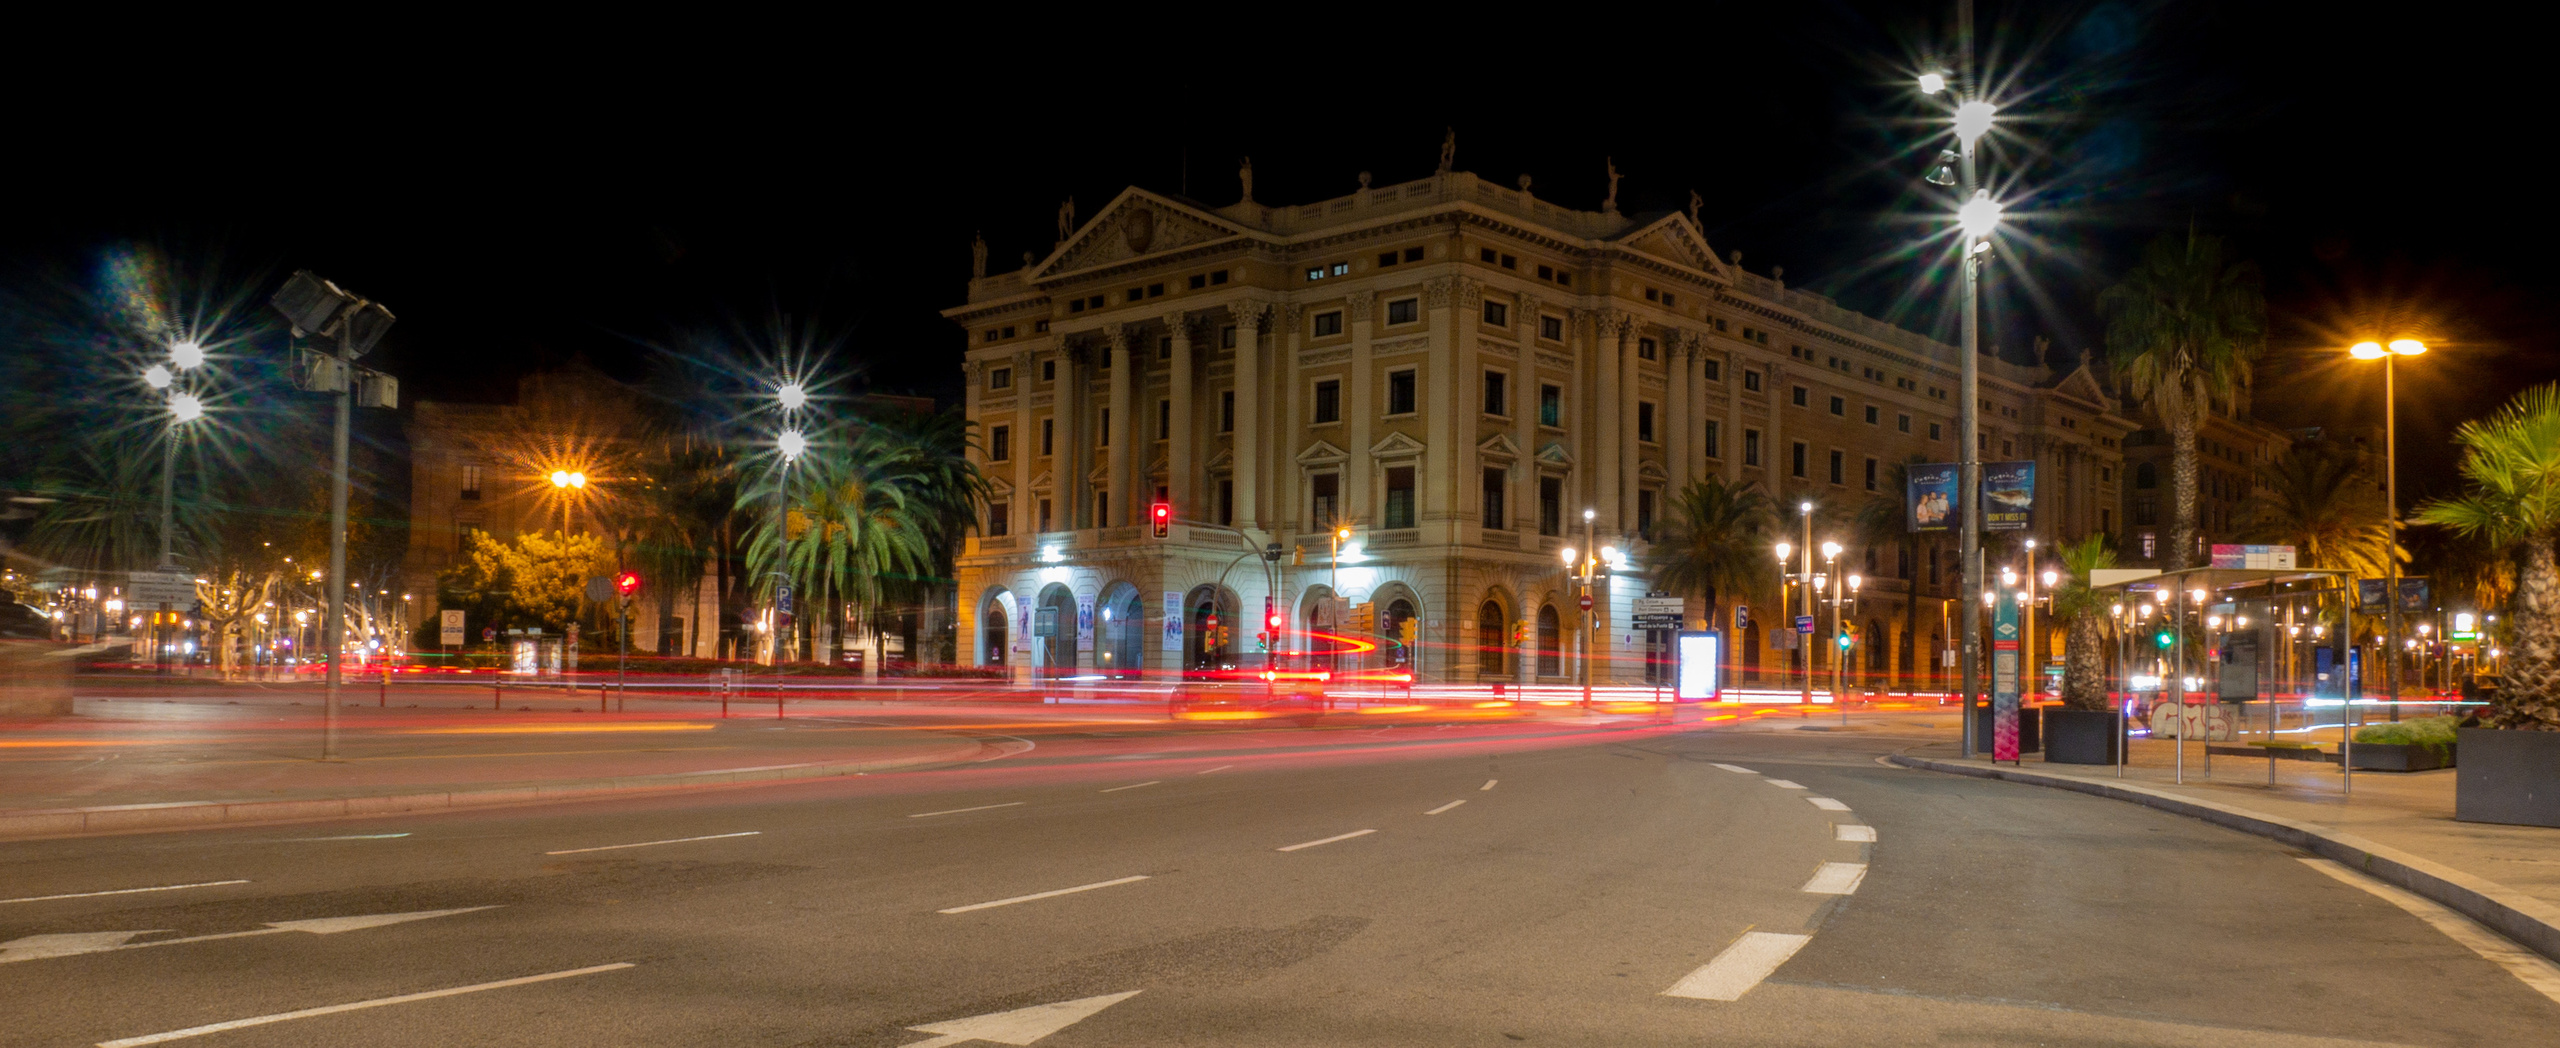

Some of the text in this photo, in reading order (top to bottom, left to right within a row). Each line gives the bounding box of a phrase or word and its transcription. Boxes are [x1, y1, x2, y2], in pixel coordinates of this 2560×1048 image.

[1988, 513, 2004, 521] DON'T
[2005, 513, 2019, 521] MISS
[779, 588, 789, 601] P
